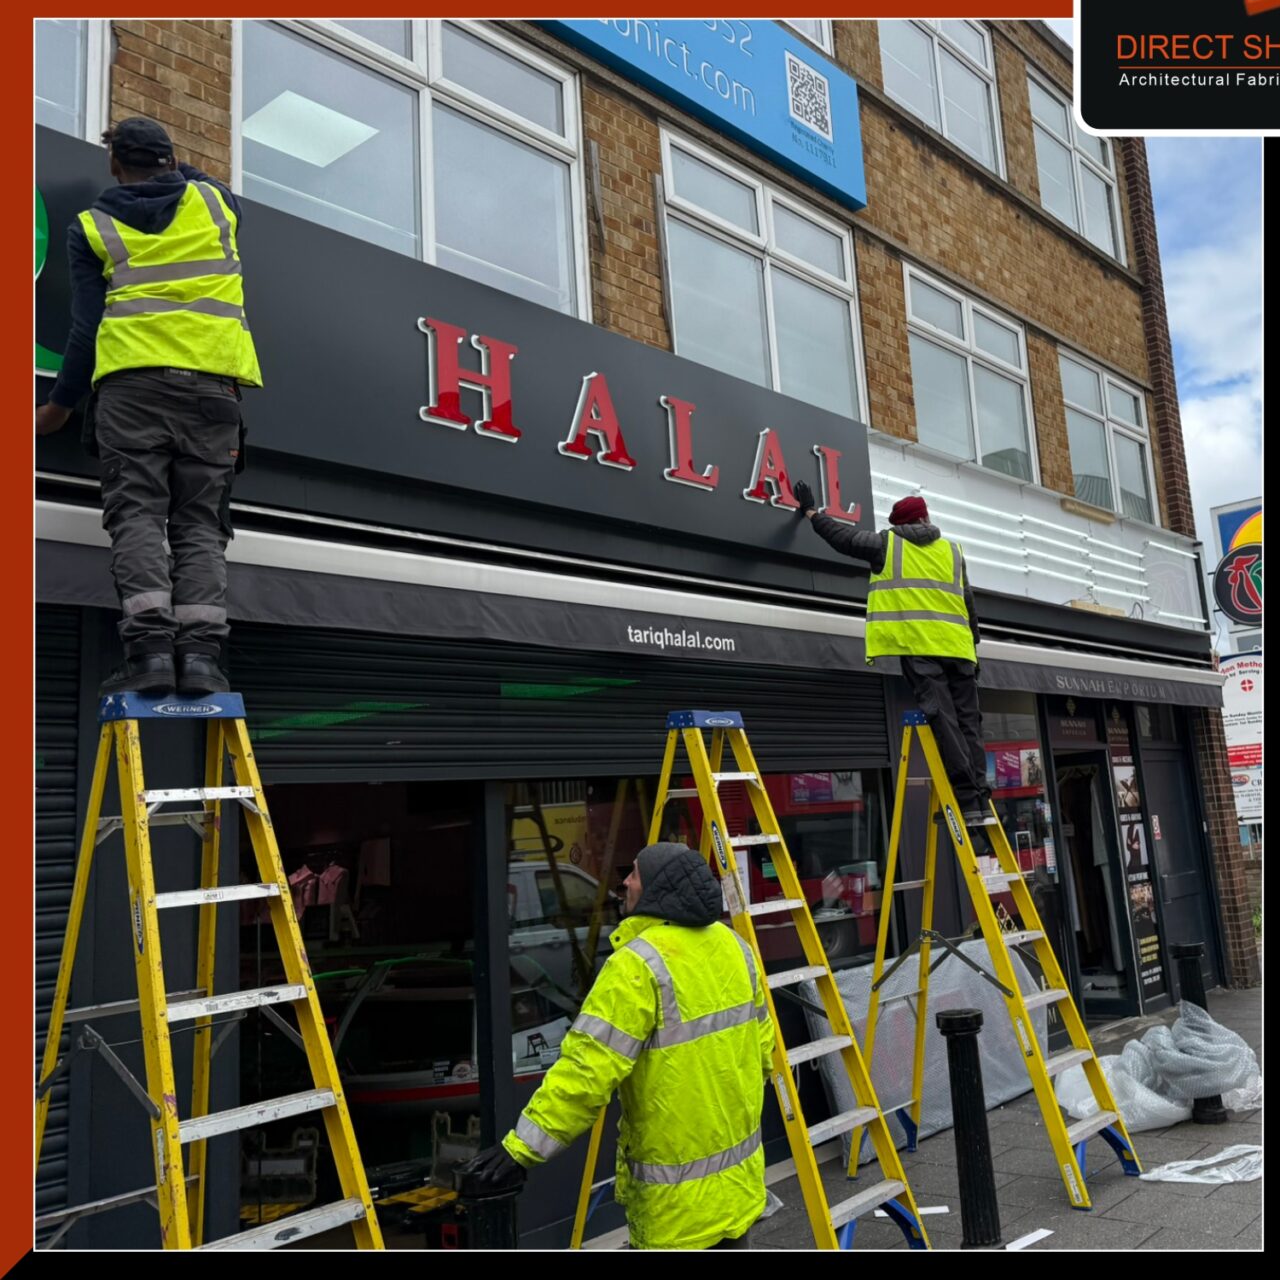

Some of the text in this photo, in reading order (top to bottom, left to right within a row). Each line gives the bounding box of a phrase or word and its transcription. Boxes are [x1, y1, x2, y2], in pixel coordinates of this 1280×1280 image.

[417, 317, 862, 525] HALAL
[627, 625, 735, 650] tariqhalal.com
[167, 705, 209, 713] WERNER
